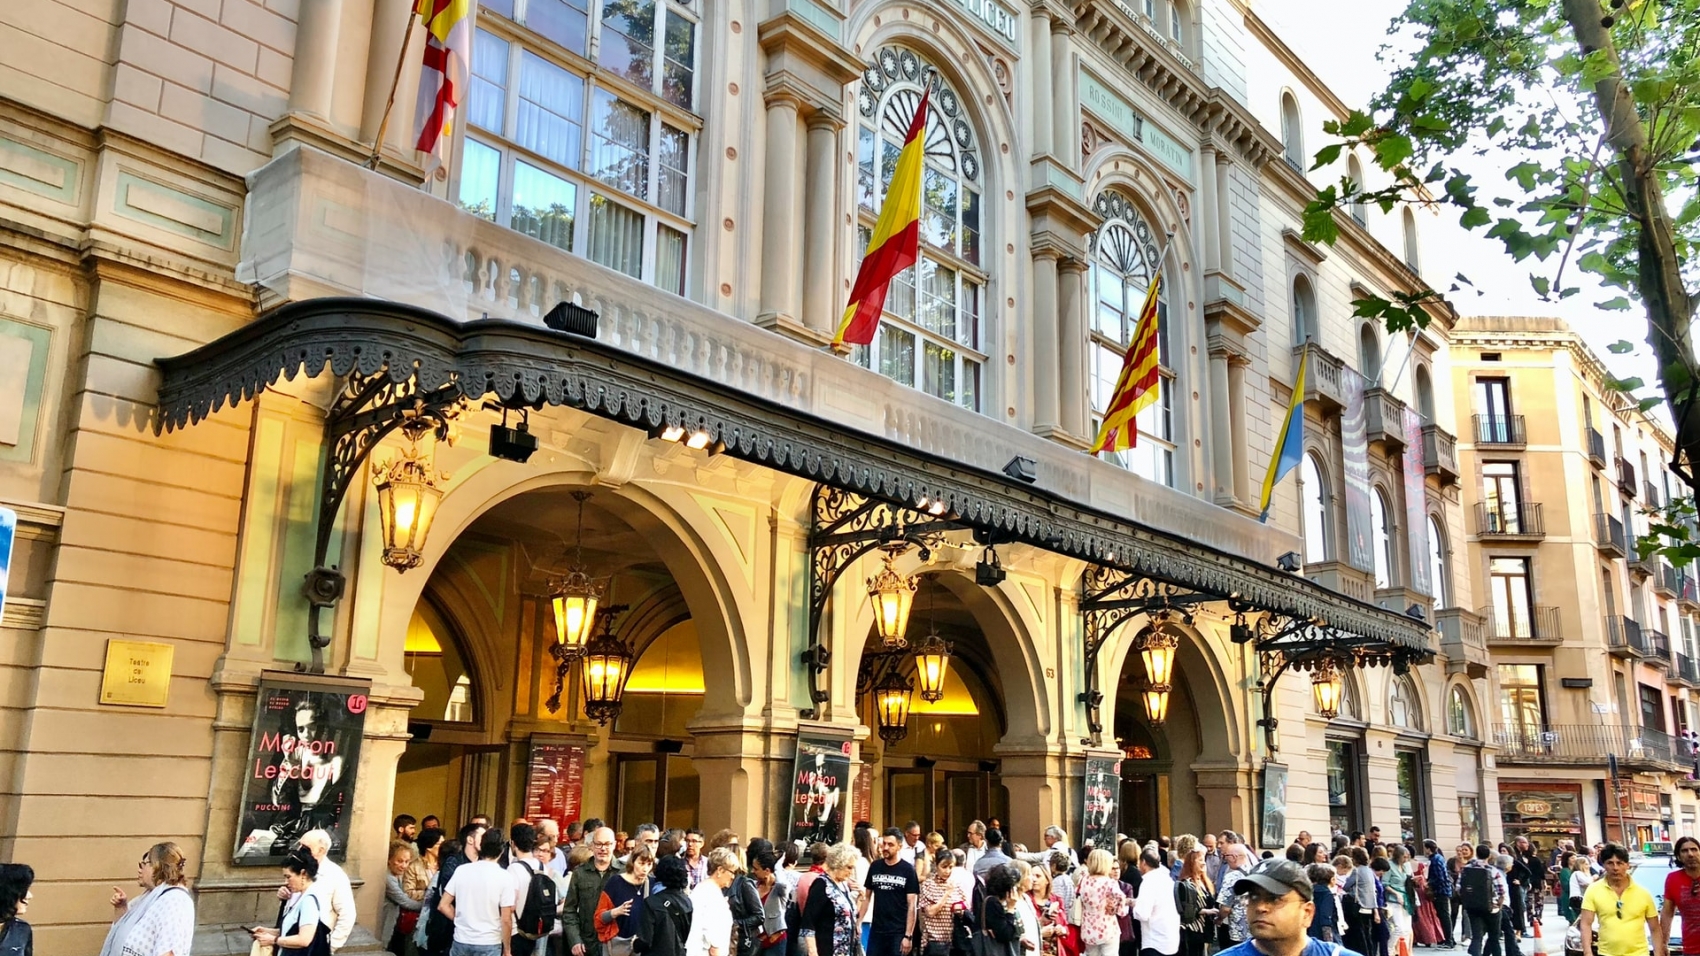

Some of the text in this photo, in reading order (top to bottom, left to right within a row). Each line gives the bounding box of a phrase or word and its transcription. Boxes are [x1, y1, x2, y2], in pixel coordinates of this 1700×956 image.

[1089, 85, 1123, 122] ROSSINI
[1150, 131, 1183, 166] MORATIN
[128, 675, 146, 684] Liceu
[1046, 667, 1055, 679] 63
[258, 731, 335, 754] Manon
[254, 758, 335, 780] Lescaut
[255, 804, 291, 812] PUCCINI
[1523, 803, 1545, 812] TAPES
